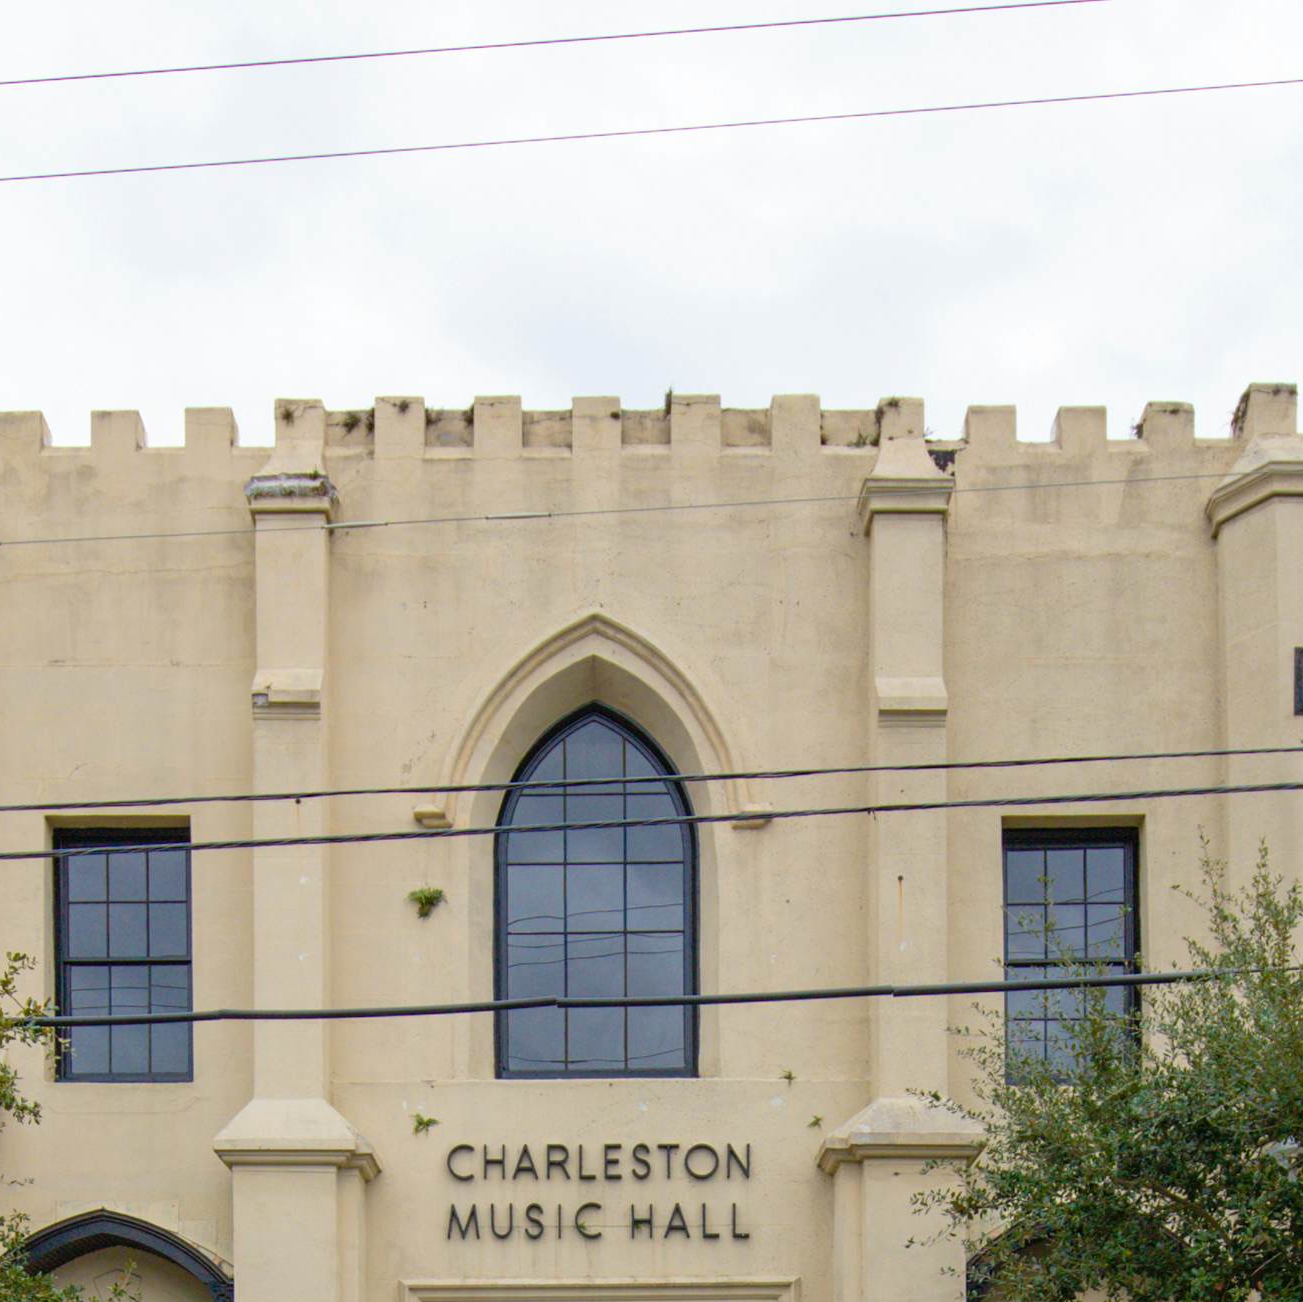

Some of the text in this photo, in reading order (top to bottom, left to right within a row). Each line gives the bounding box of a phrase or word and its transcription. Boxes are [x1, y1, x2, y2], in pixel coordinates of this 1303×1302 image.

[447, 1143, 751, 1181] CHARLESTON
[447, 1202, 750, 1240] MUSIC HALL
